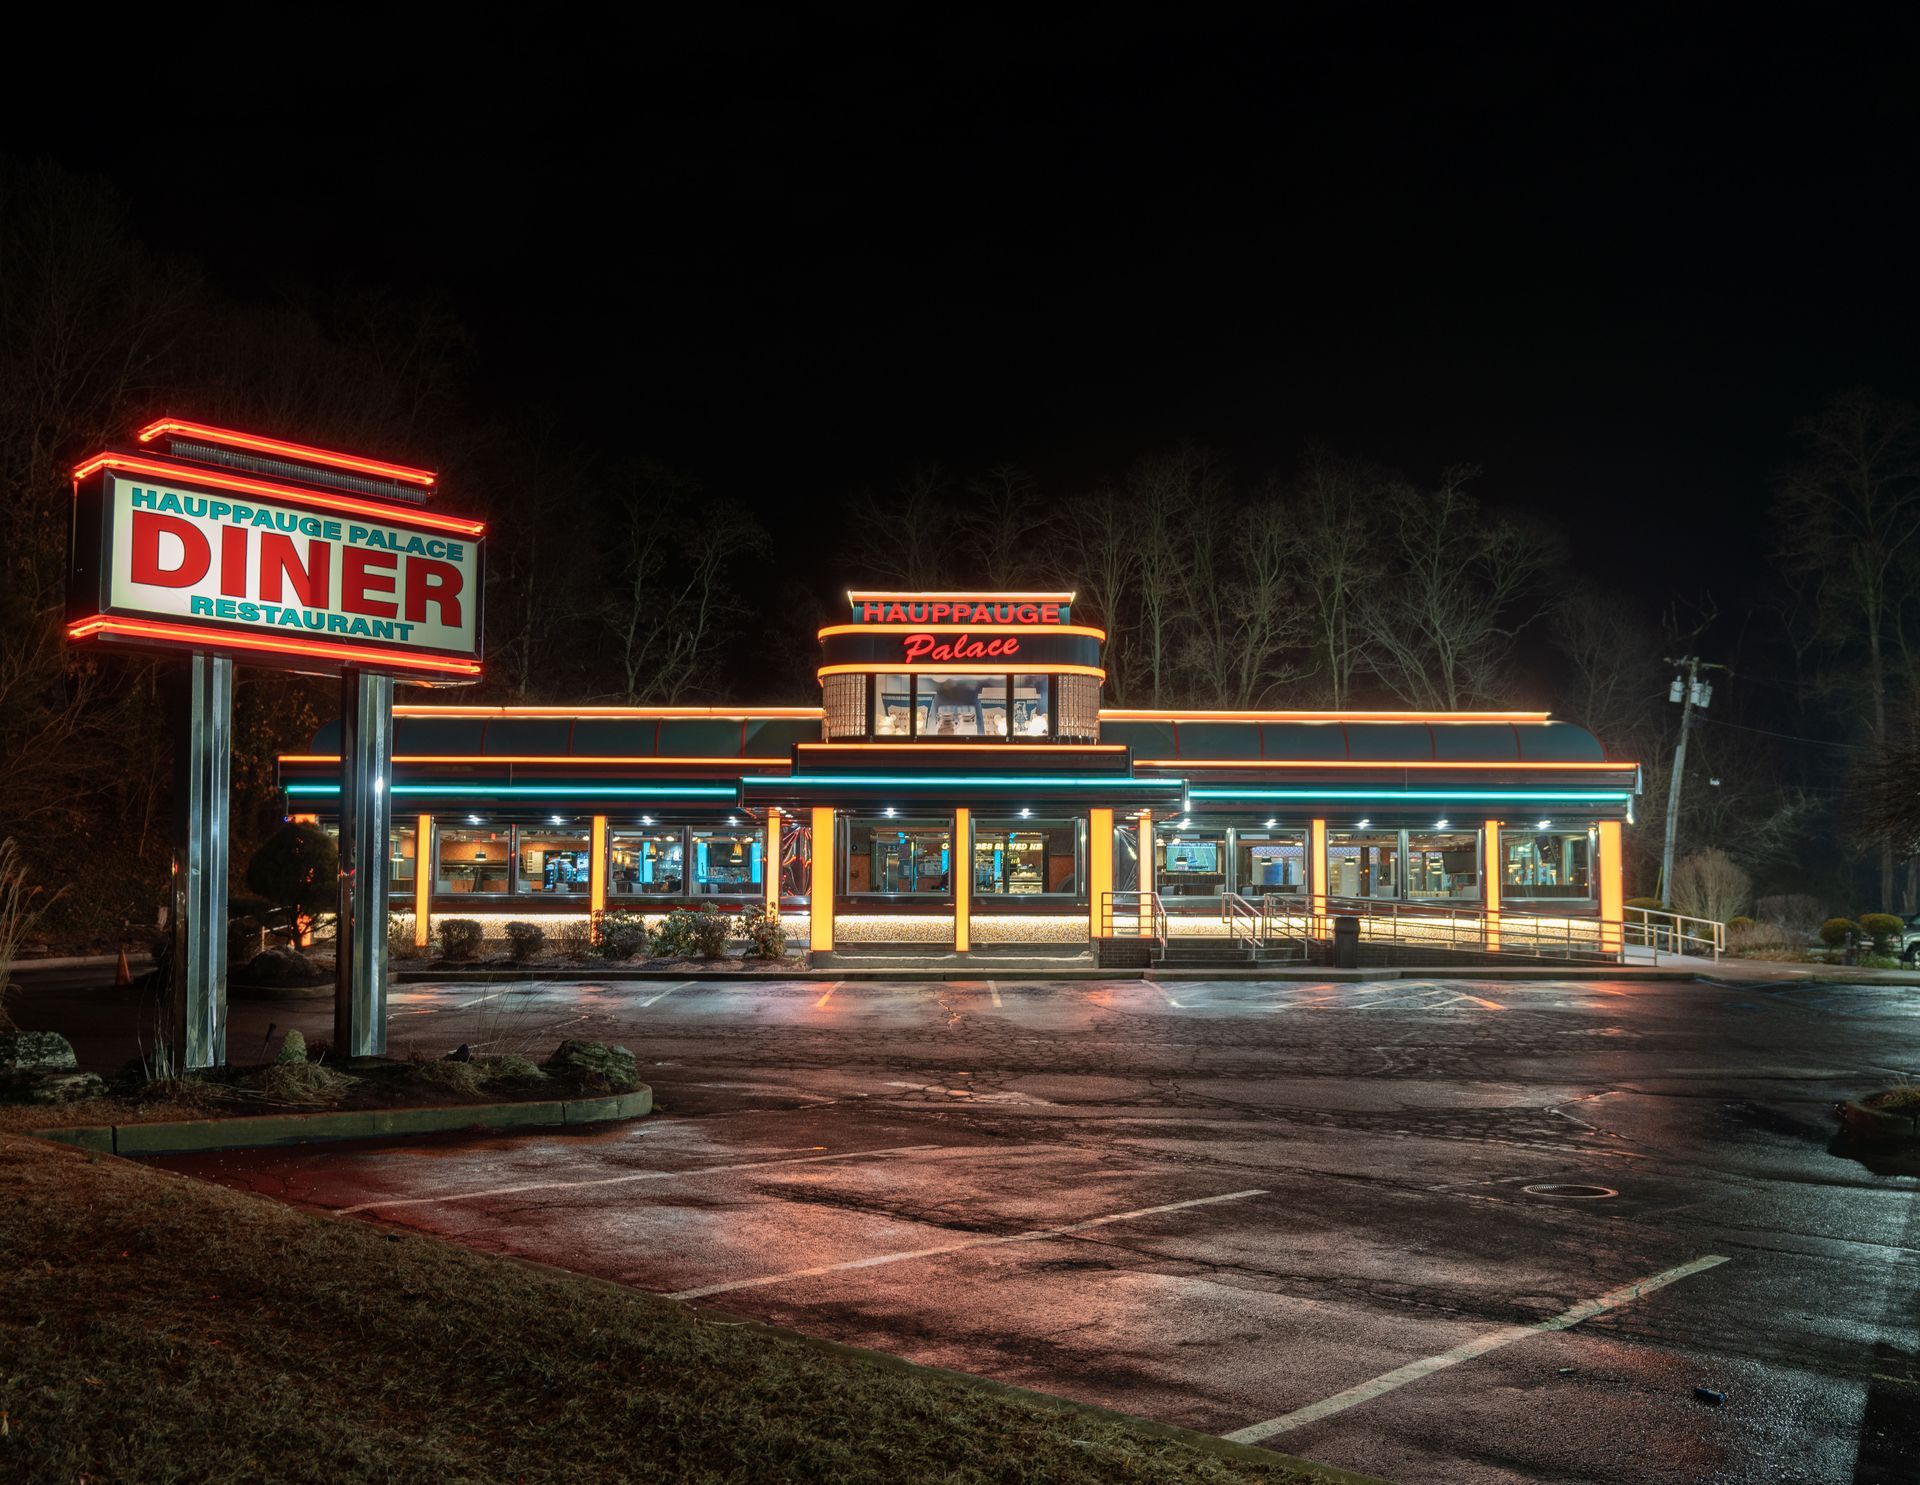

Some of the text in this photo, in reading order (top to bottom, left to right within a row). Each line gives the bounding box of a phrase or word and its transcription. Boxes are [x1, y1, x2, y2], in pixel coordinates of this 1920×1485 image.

[131, 487, 464, 562] HAUPPAUGE PALACE
[130, 509, 464, 628] DINER
[190, 595, 415, 642] RESTAURANT
[863, 602, 1060, 624] HAUPPAUGE
[903, 633, 1020, 664] Palace
